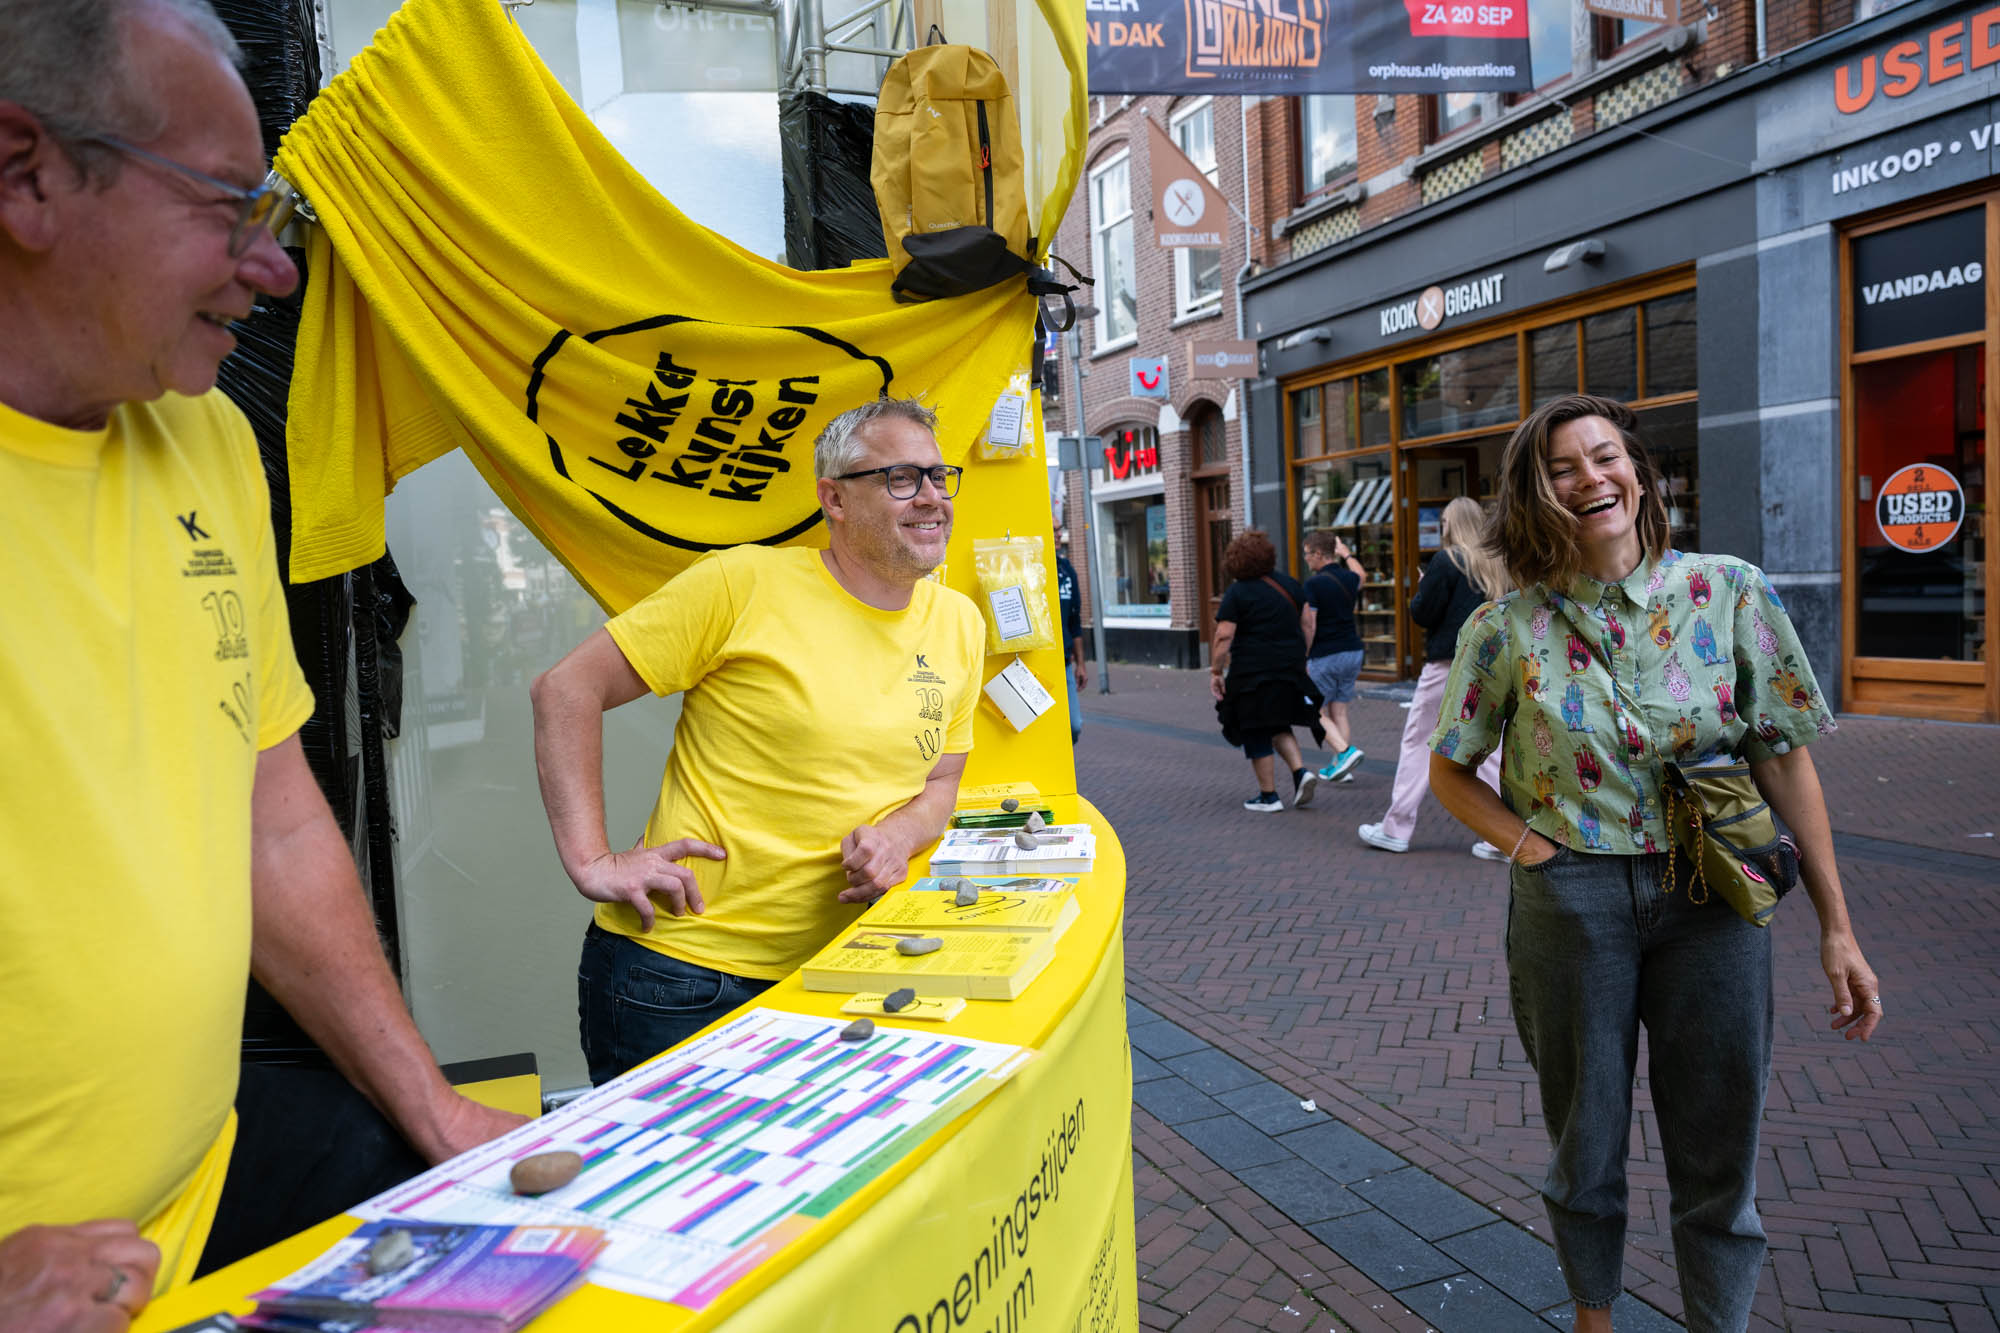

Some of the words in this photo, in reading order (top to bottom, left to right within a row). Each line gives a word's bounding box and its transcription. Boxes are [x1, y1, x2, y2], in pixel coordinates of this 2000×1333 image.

[1421, 4, 1448, 24] ZA
[1451, 6, 1474, 24] 20
[1477, 6, 1513, 25] SEP
[1108, 22, 1165, 47] DAK
[1368, 62, 1516, 80] orpheus.nl/generations
[1835, 7, 2000, 114] USED
[1832, 142, 1942, 194] INKOOP
[1863, 262, 1982, 305] VANDAAG
[1381, 300, 1418, 336] KOOK
[1445, 273, 1504, 317] GIGANT
[588, 352, 697, 482] Lekker
[650, 378, 758, 490] kunst
[709, 376, 820, 502] kijken
[1914, 468, 1925, 482] 2
[1886, 491, 1953, 515] USED
[177, 511, 211, 541] K
[1889, 511, 1951, 525] PRODUCTS
[1914, 526, 1923, 539] 4
[201, 590, 244, 639] 10
[916, 654, 929, 668] K
[915, 688, 943, 710] 10
[914, 734, 926, 754] KUNST
